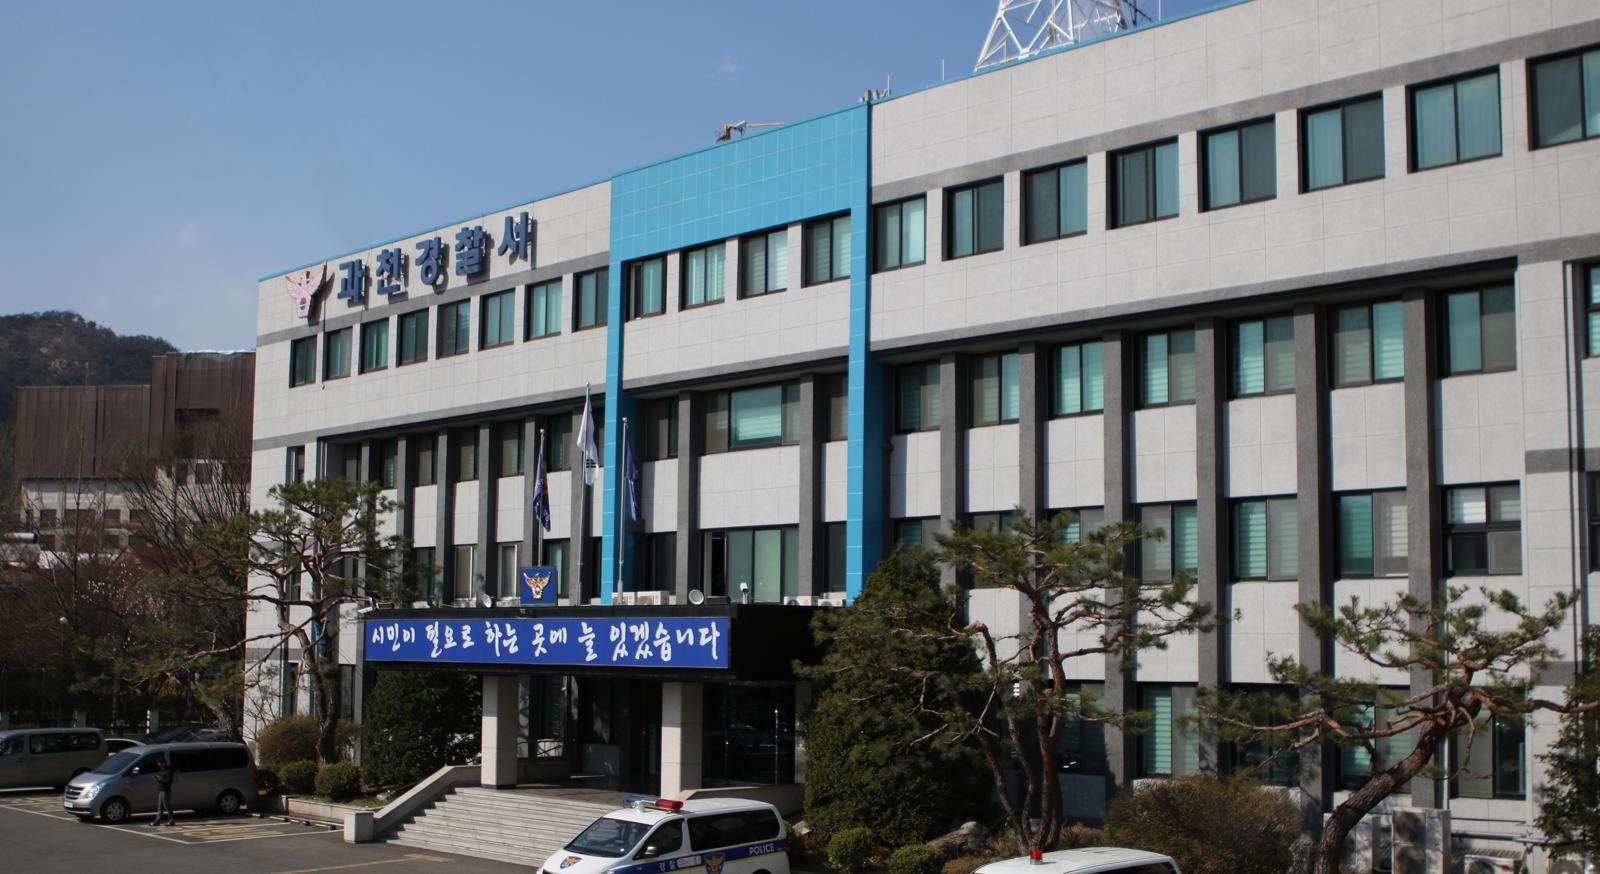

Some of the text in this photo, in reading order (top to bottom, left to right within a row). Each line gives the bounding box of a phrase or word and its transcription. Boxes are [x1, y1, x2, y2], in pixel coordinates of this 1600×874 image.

[337, 211, 529, 304] 과천경찰서
[372, 621, 721, 662] 시민이 필요로 하는 곳에 늘 있겠습니다
[749, 843, 775, 856] POLICE
